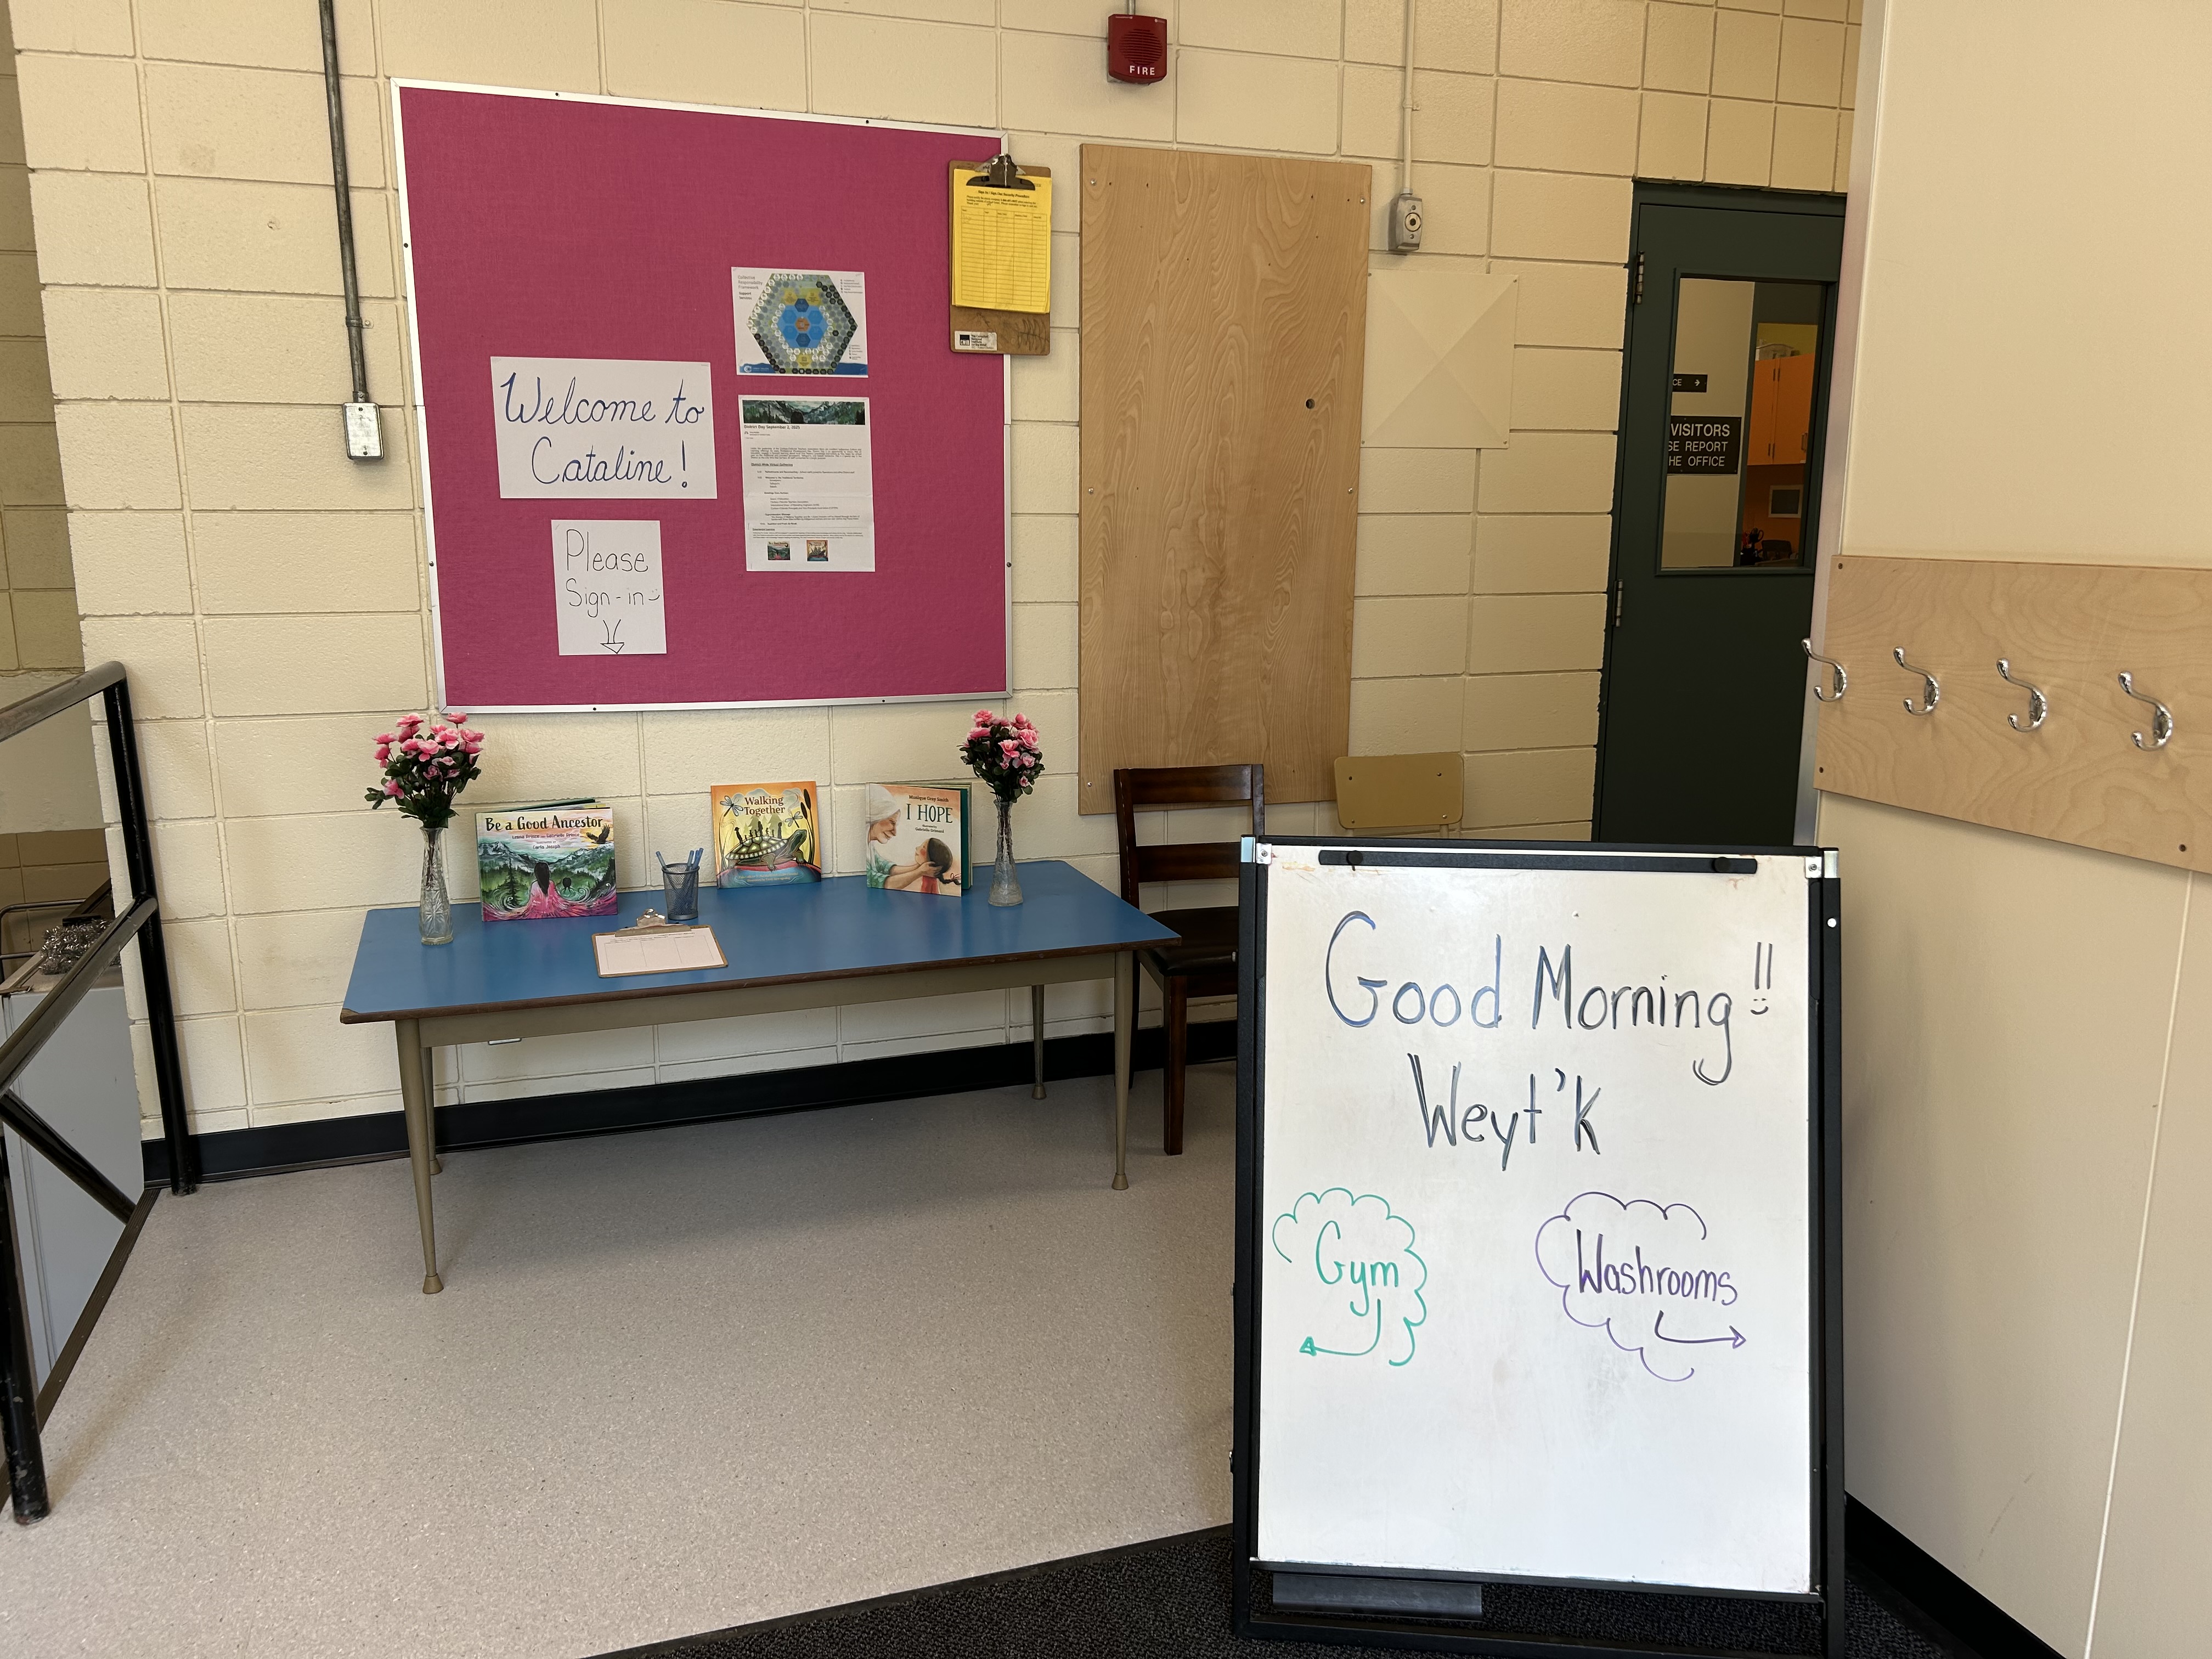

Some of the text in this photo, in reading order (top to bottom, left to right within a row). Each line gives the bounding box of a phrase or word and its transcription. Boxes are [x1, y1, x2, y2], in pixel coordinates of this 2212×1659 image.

[1130, 65, 1155, 76] FIRE
[500, 372, 704, 424] Welcome to
[1671, 423, 1730, 437] VISITORS
[1685, 441, 1728, 452] REPORT
[1688, 456, 1725, 466] OFFICE
[566, 529, 648, 572] Please
[744, 796, 784, 806] Walking
[744, 805, 786, 817] Together
[906, 804, 953, 823] I HOPE
[485, 815, 603, 831] Be a Good Ancestor
[1326, 911, 1502, 1028] Good
[1316, 1220, 1399, 1317] Gym
[1577, 1229, 1738, 1306] Washrooms
